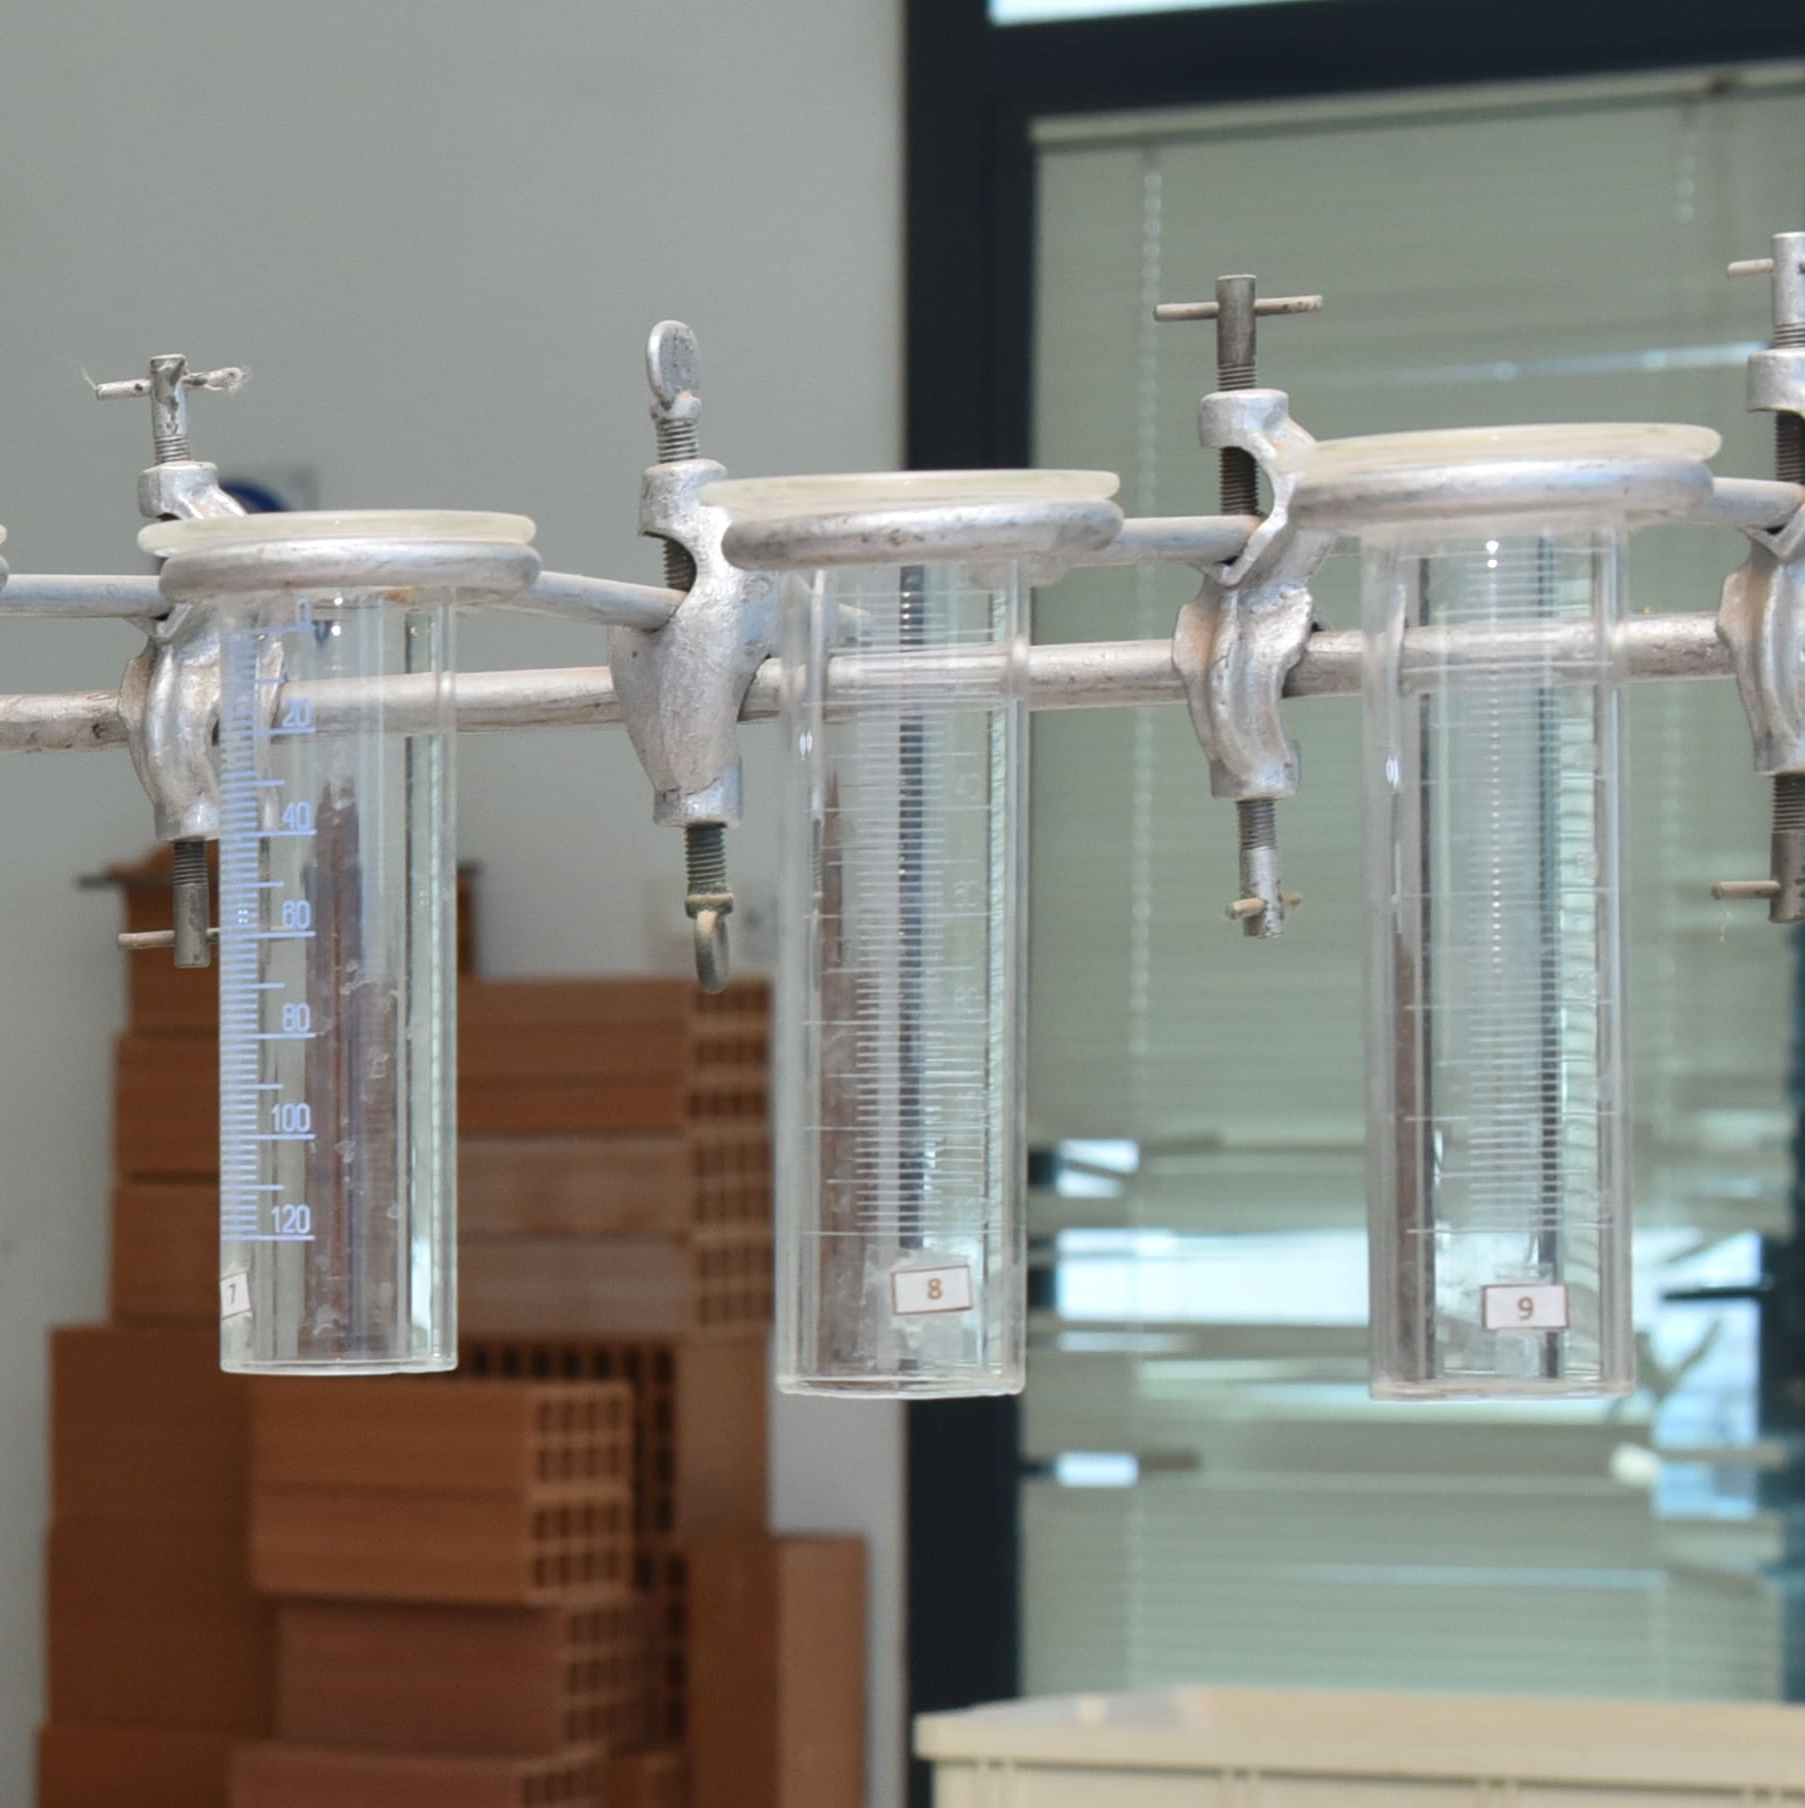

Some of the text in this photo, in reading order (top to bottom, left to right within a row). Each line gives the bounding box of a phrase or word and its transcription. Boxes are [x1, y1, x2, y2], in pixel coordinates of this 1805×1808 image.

[282, 698, 312, 728] 20
[282, 802, 312, 831] 40
[282, 900, 312, 930] 60
[282, 1004, 311, 1033] 80
[271, 1103, 311, 1133] 100
[271, 1205, 311, 1235] 120
[227, 1283, 238, 1305] 7
[927, 1277, 943, 1301] 8
[1516, 1297, 1535, 1321] 9
